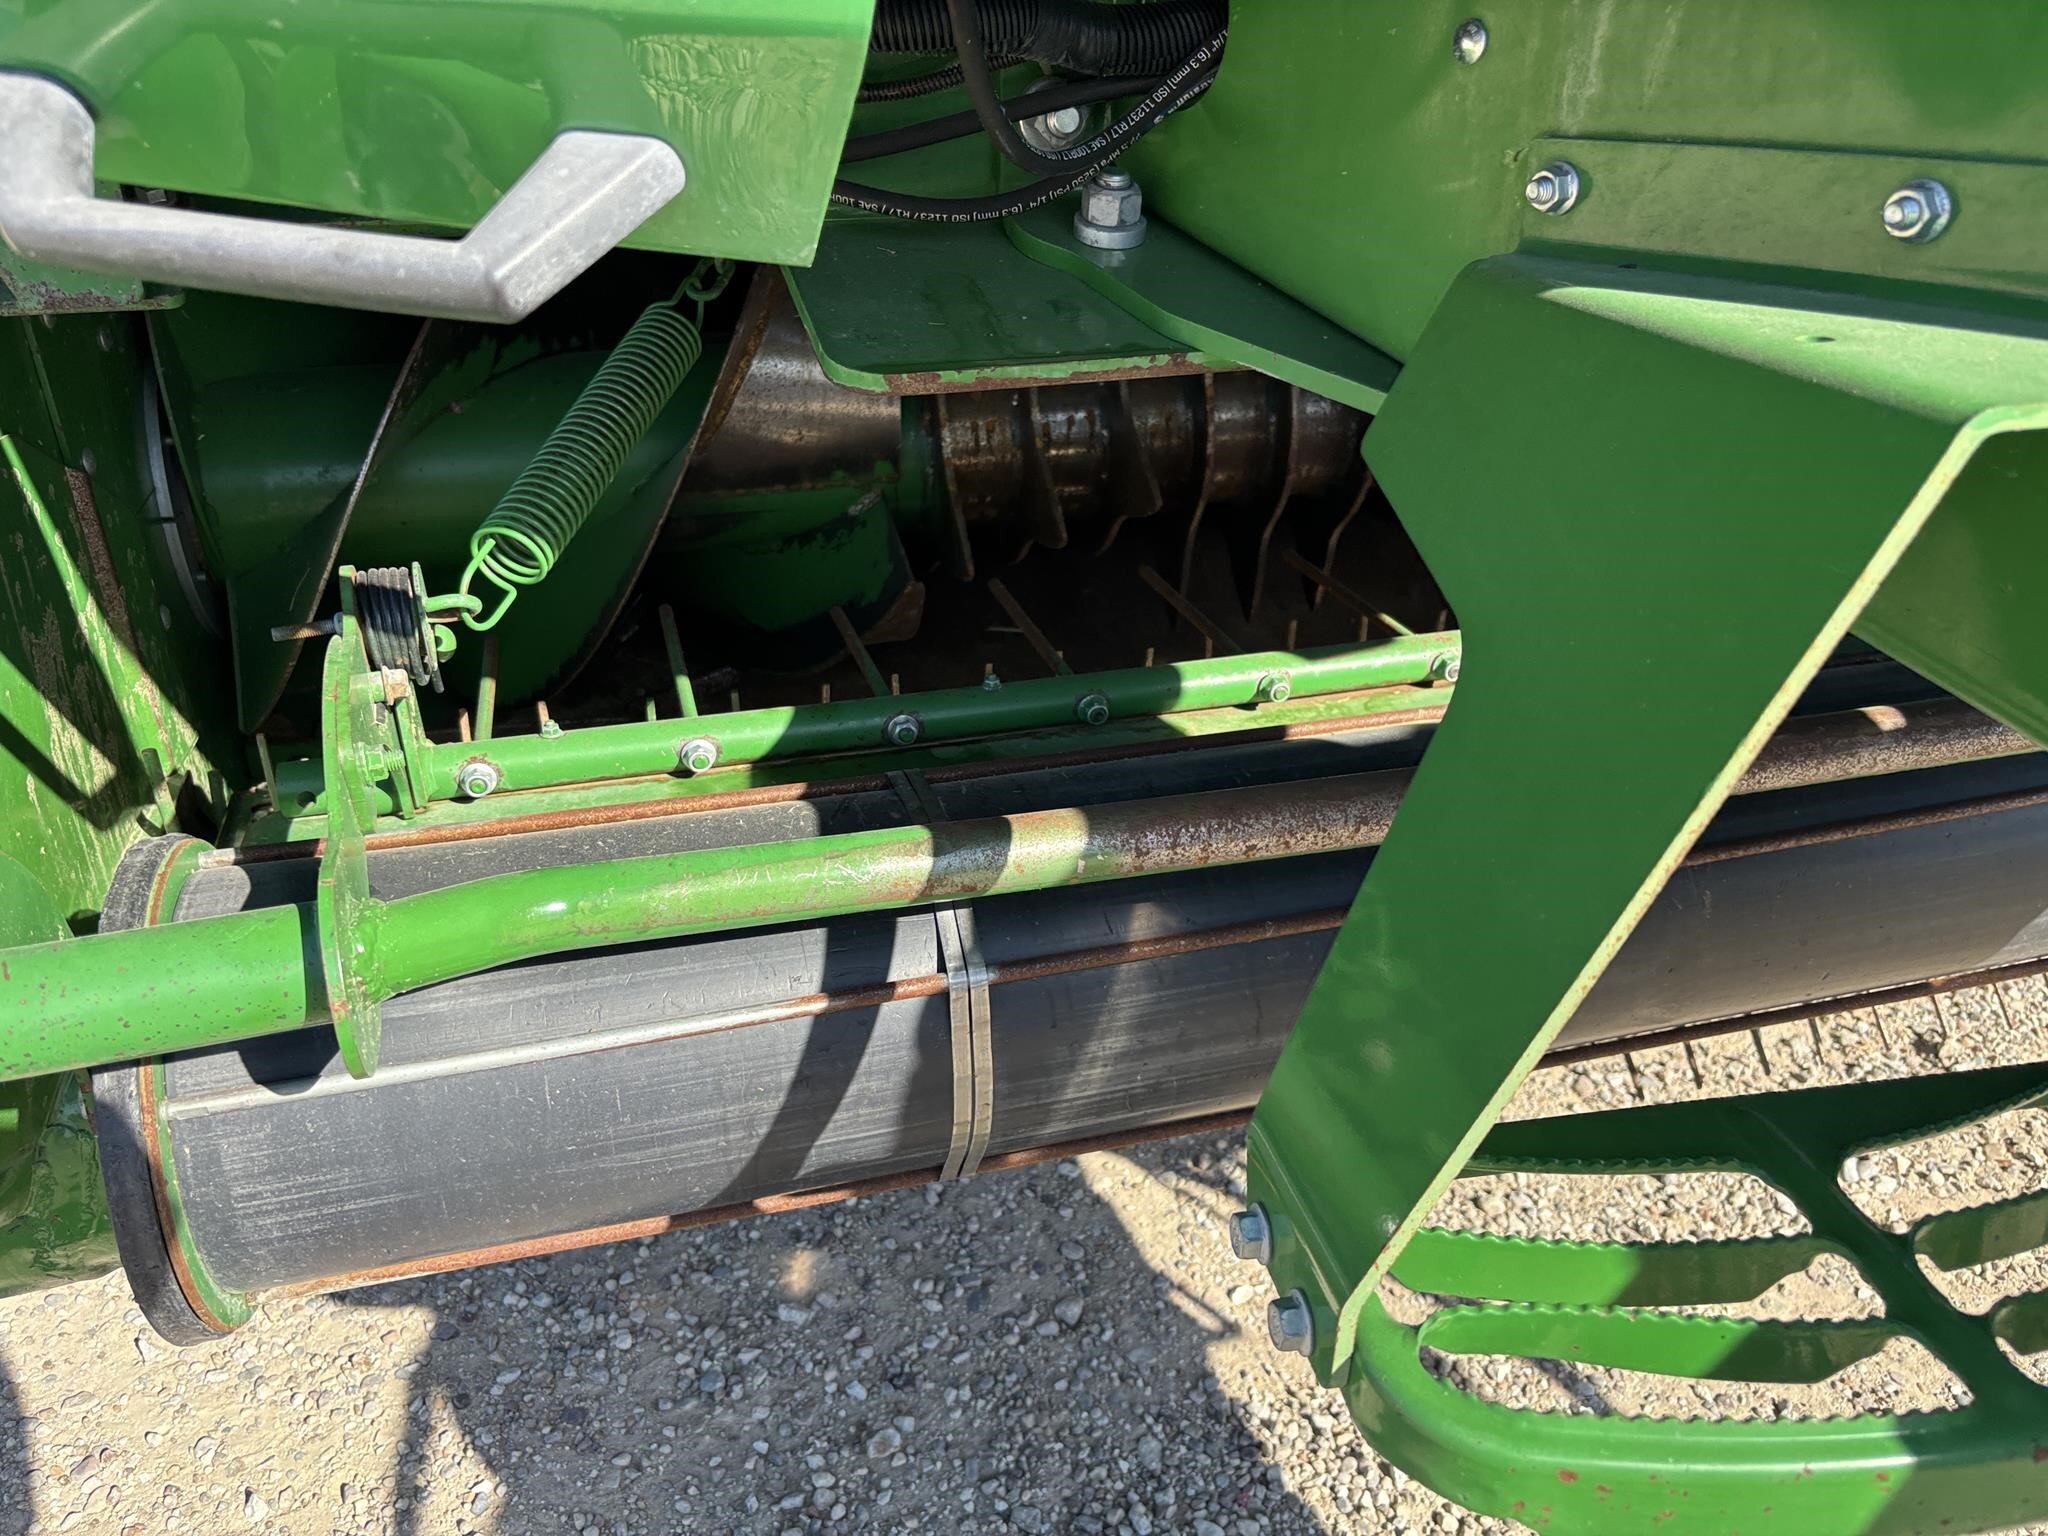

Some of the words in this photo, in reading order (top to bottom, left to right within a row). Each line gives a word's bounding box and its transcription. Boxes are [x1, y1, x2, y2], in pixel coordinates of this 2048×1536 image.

[1152, 85, 1171, 103] ISO
[1127, 99, 1155, 126] 11237
[1110, 121, 1129, 139] R17
[1090, 136, 1107, 151] SAE
[1062, 145, 1091, 160] 100R17
[951, 214, 970, 223] ISO
